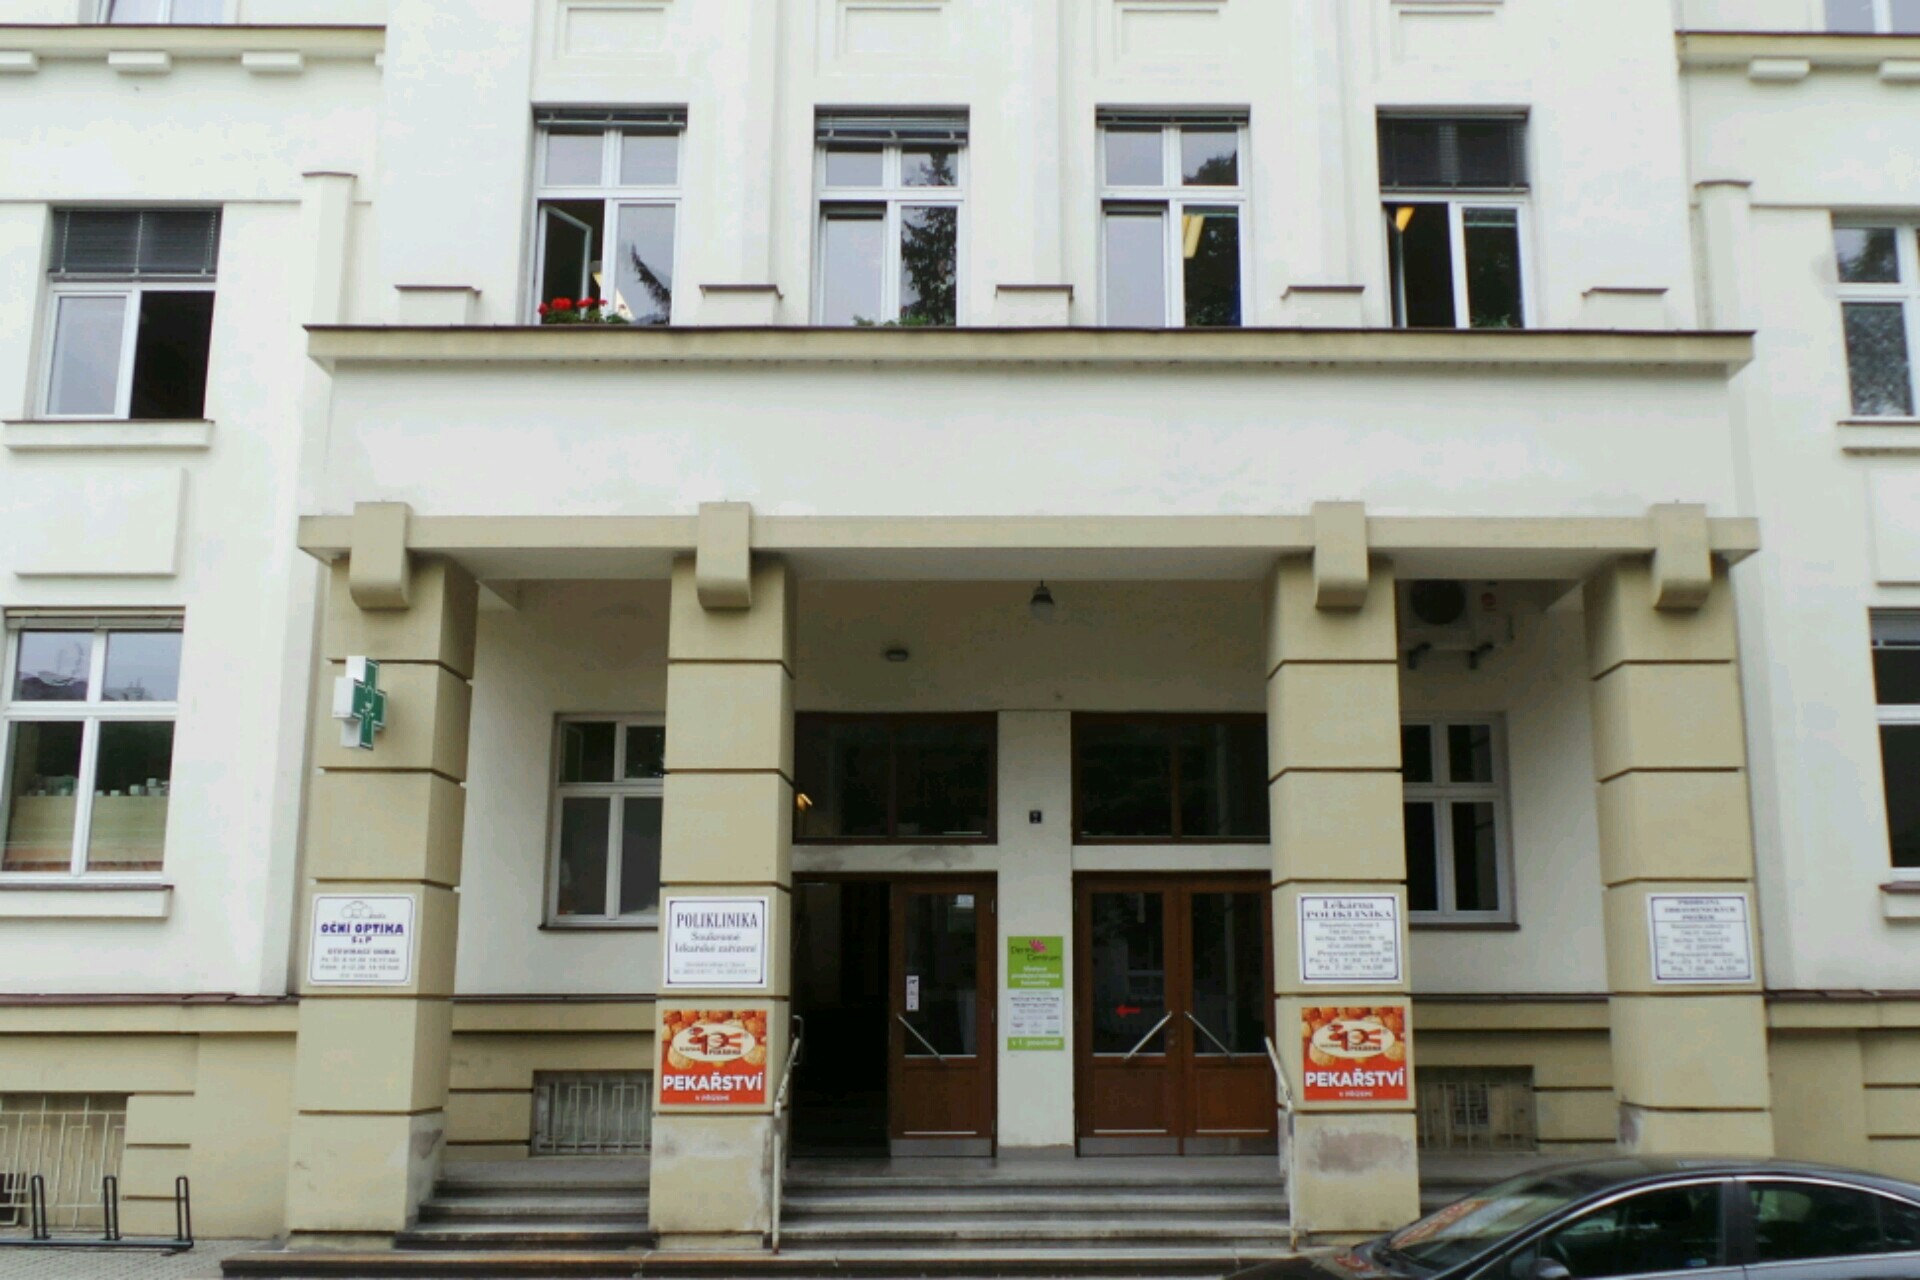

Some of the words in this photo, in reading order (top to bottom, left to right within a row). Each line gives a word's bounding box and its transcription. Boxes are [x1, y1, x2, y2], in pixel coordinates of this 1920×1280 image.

[321, 921, 350, 933] OČNÍ
[355, 924, 404, 933] OPTIKA
[677, 912, 757, 928] POLIKLINIKA
[663, 1072, 762, 1091] PEKAŘSTVÍ
[1305, 1068, 1404, 1087] PEKAŘSTVÍ
